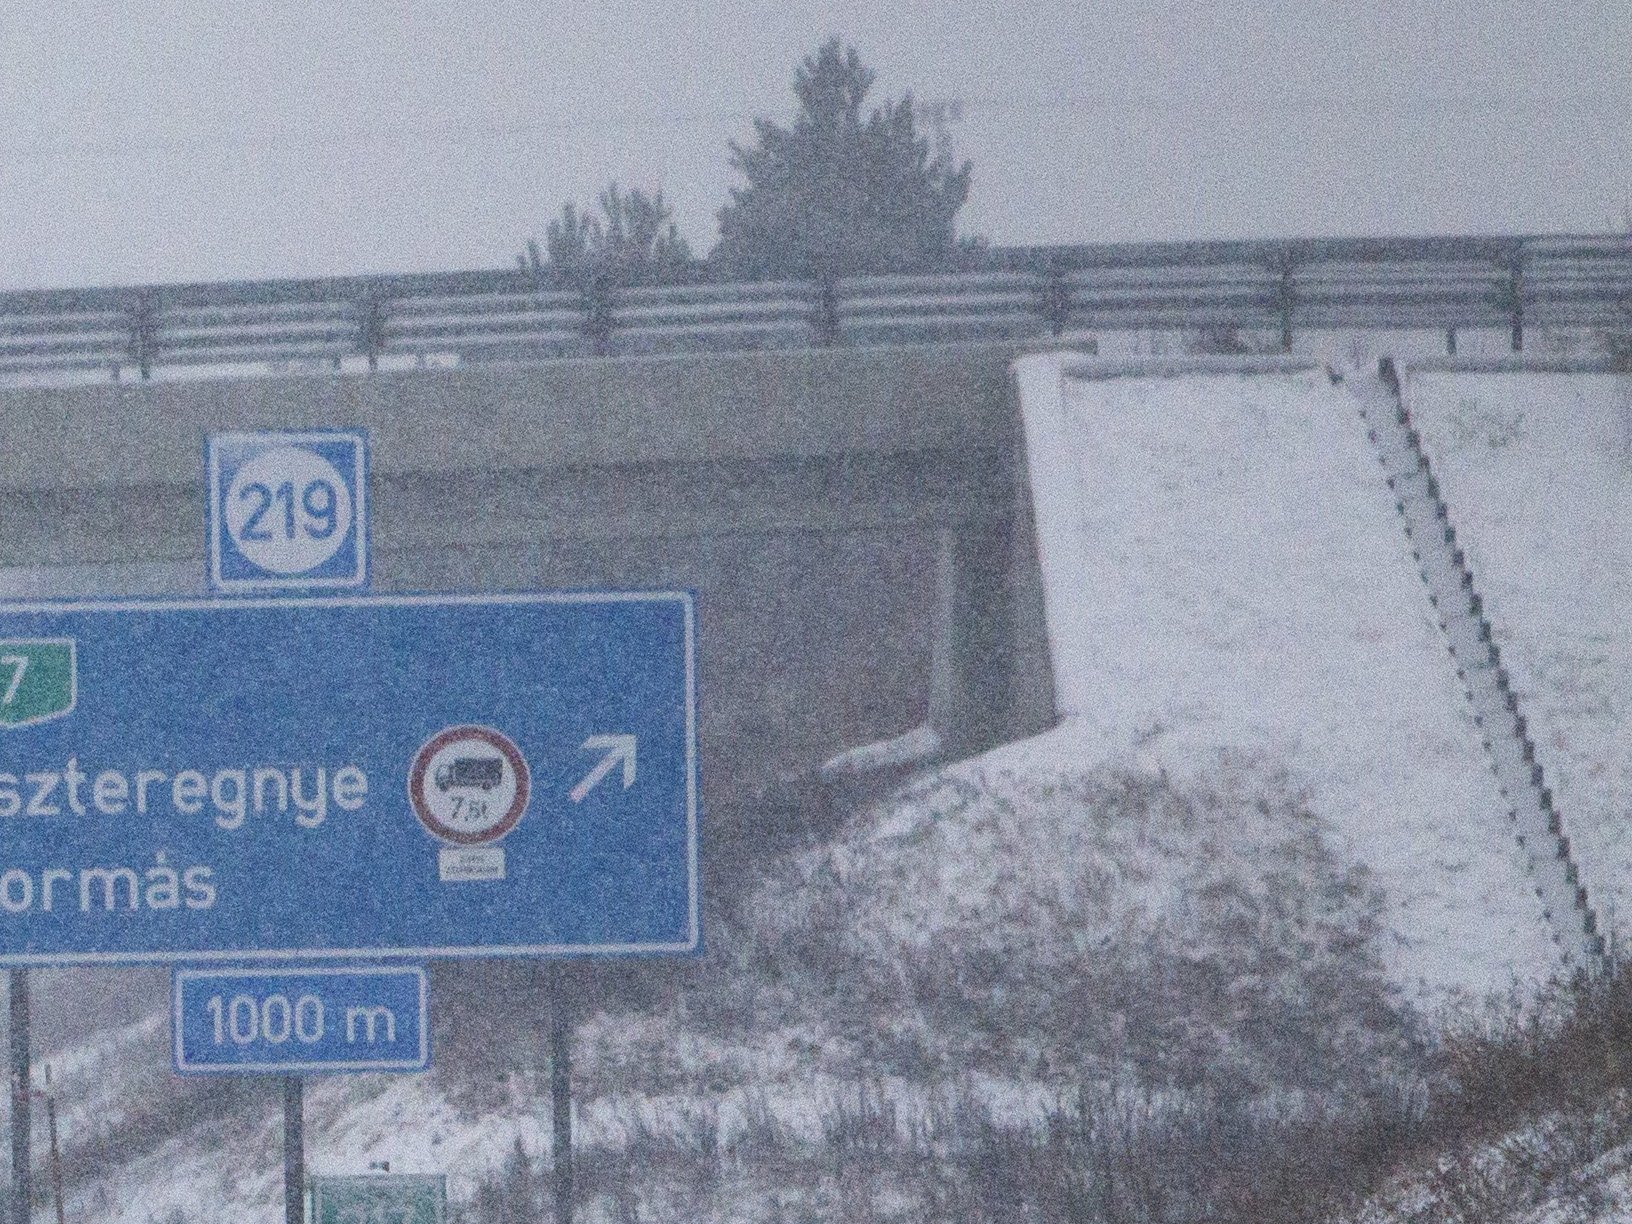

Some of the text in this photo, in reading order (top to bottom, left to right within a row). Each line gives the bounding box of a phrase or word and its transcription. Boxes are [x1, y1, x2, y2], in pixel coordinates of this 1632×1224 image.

[237, 479, 337, 543] 219
[0, 655, 30, 705] 7
[206, 994, 396, 1045] 1000 m
